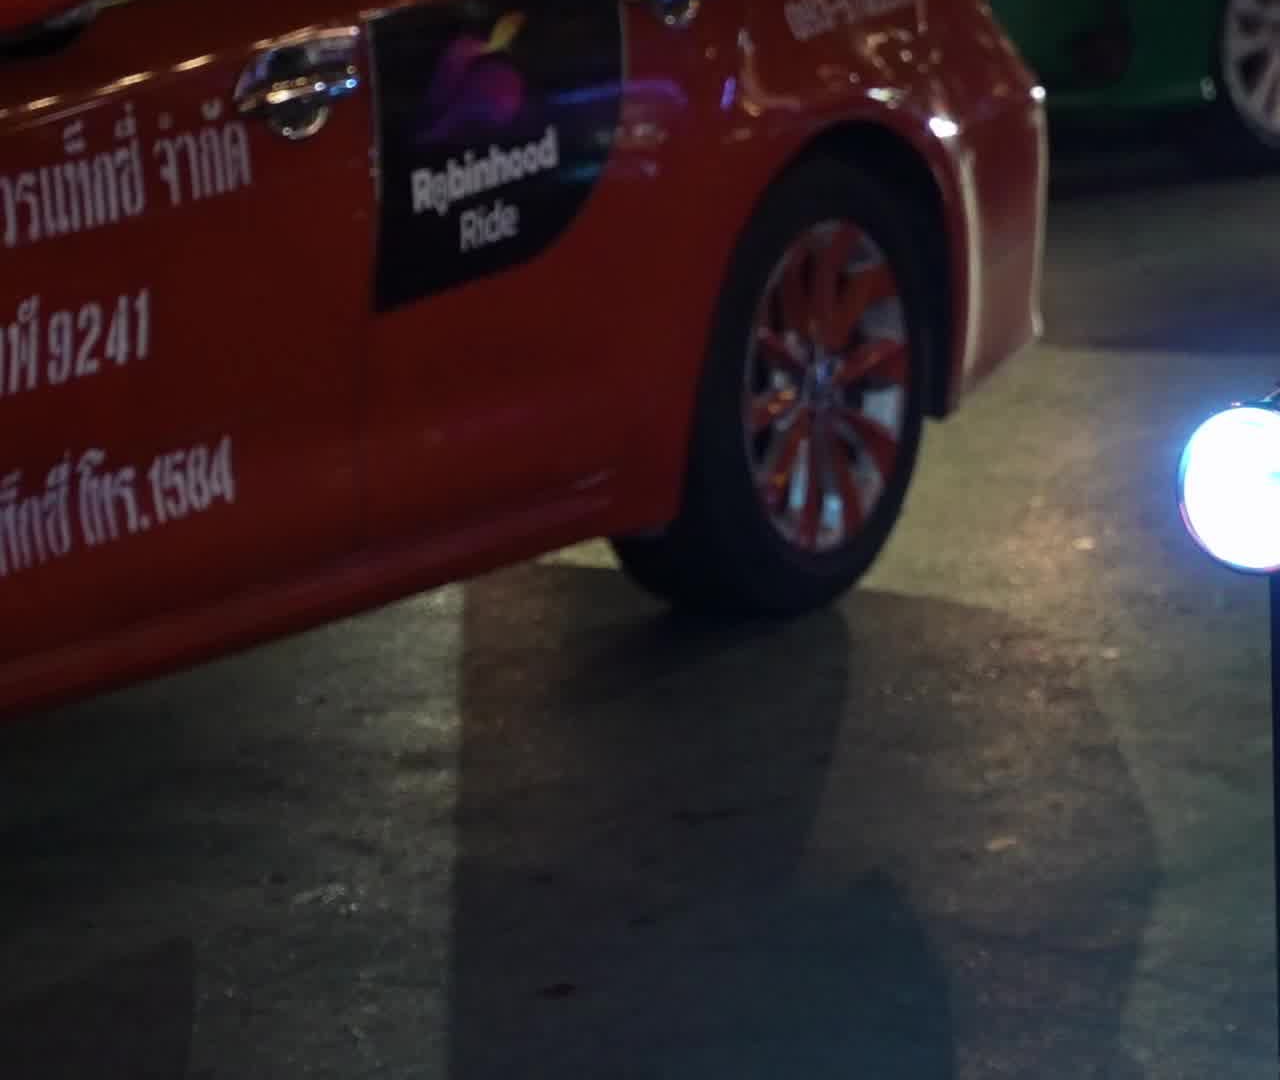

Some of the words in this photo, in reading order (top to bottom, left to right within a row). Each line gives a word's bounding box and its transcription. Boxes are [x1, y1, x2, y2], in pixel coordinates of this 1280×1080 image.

[152, 99, 253, 207] จำกัด
[410, 123, 560, 217] Robinhood
[457, 197, 521, 255] Ride
[46, 287, 153, 386] 9241
